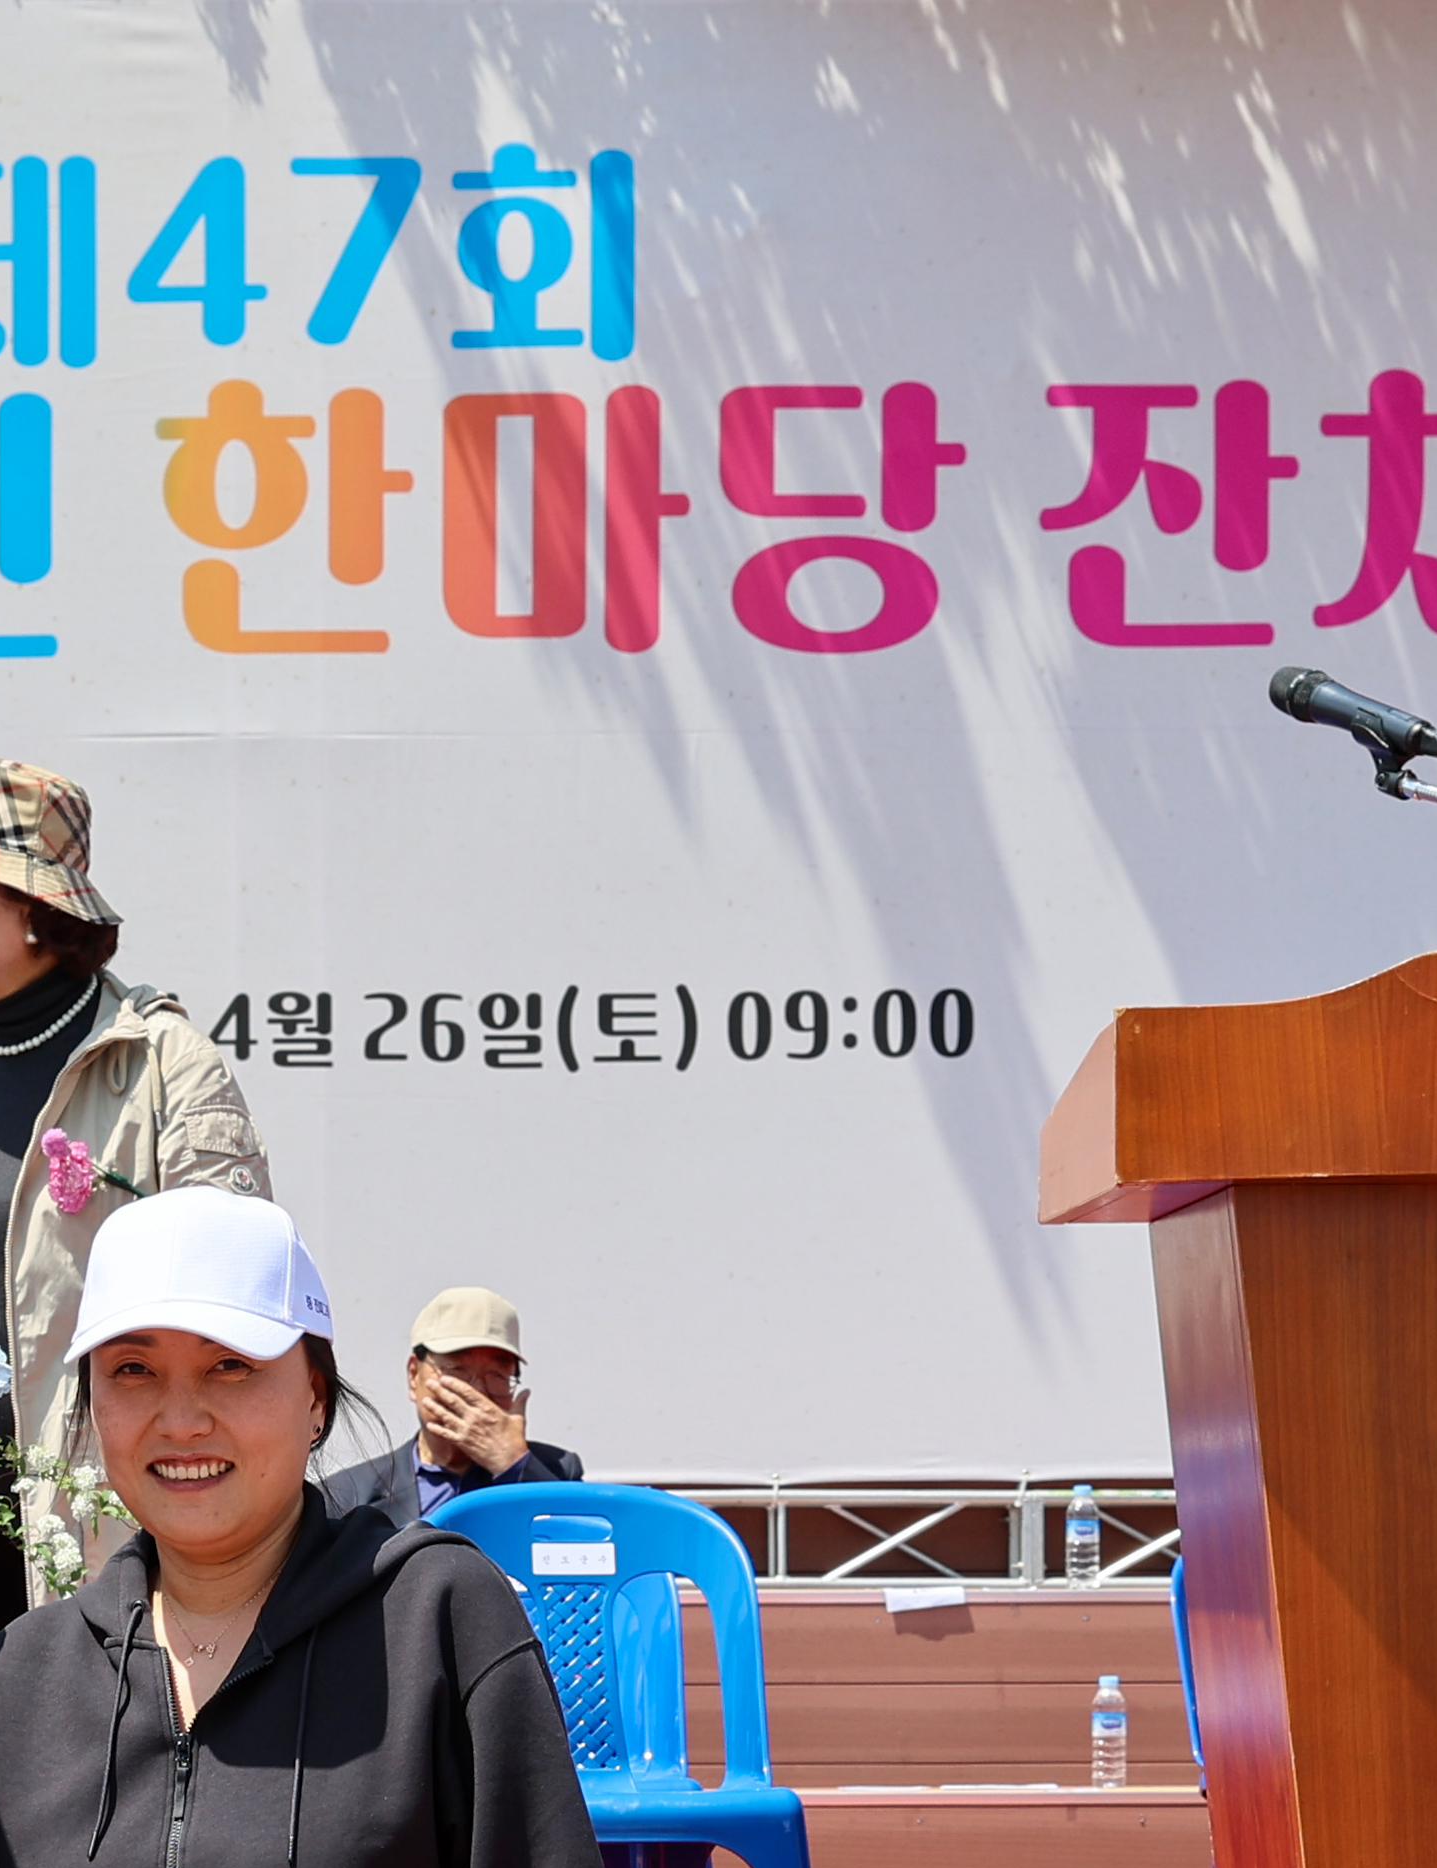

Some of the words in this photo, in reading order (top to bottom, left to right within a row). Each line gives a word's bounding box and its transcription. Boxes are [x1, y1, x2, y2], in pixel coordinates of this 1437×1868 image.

[159, 379, 968, 656] 한마당
[210, 991, 334, 1067] 4월
[365, 985, 697, 1072] 26일(토)
[728, 989, 973, 1060] 09:00
